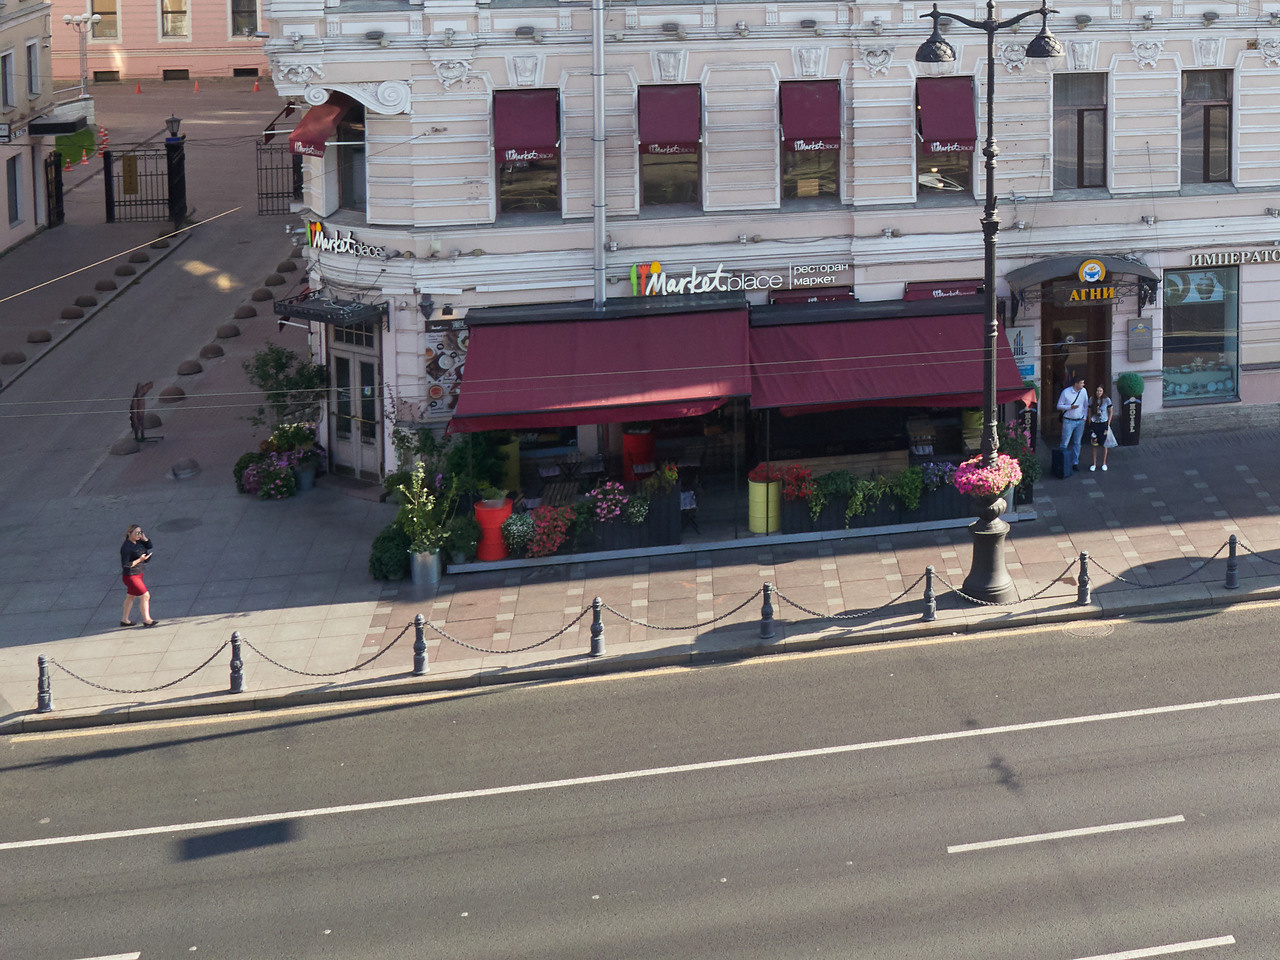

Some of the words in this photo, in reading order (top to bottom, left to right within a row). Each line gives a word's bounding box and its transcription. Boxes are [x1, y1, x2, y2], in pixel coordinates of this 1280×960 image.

[313, 230, 383, 257] Marketplace
[793, 263, 849, 275] ресторан
[645, 262, 783, 296] Marketplace
[793, 275, 837, 286] маркет
[1069, 286, 1115, 302] АГНИ
